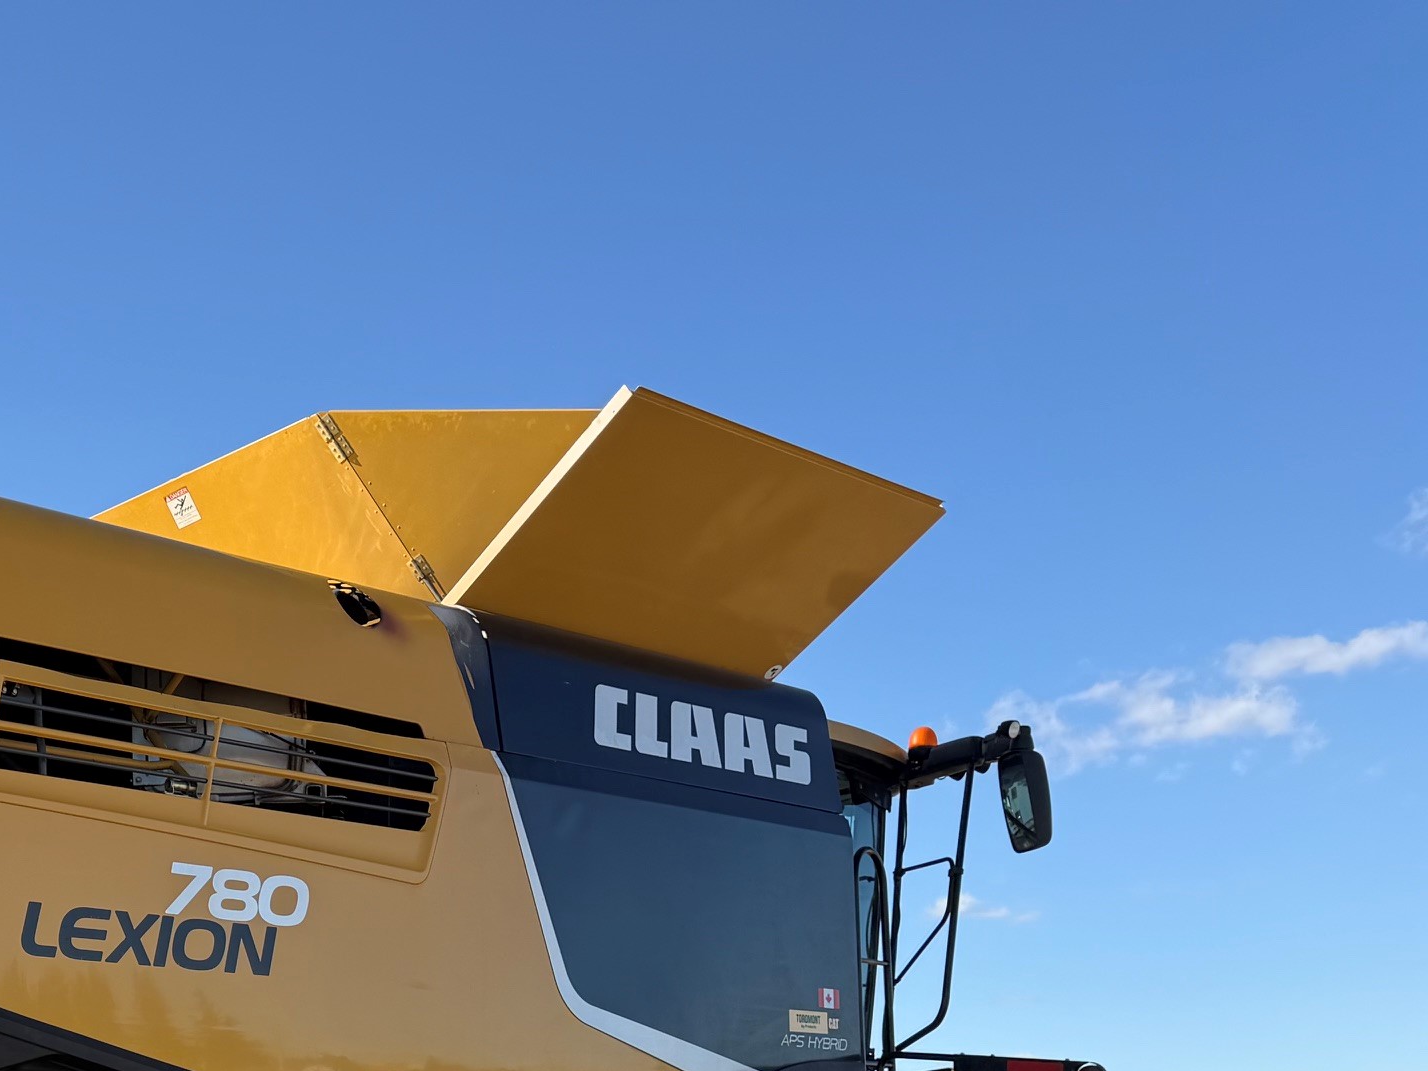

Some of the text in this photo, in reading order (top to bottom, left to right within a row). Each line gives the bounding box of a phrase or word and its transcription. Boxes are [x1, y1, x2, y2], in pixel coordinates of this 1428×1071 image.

[594, 684, 811, 785] CLAAS
[164, 861, 310, 927] 780
[20, 900, 278, 977] LEXION
[795, 1013, 821, 1025] TOROMONT
[828, 1017, 839, 1030] CAT
[780, 1034, 848, 1051] APS HYBRID
